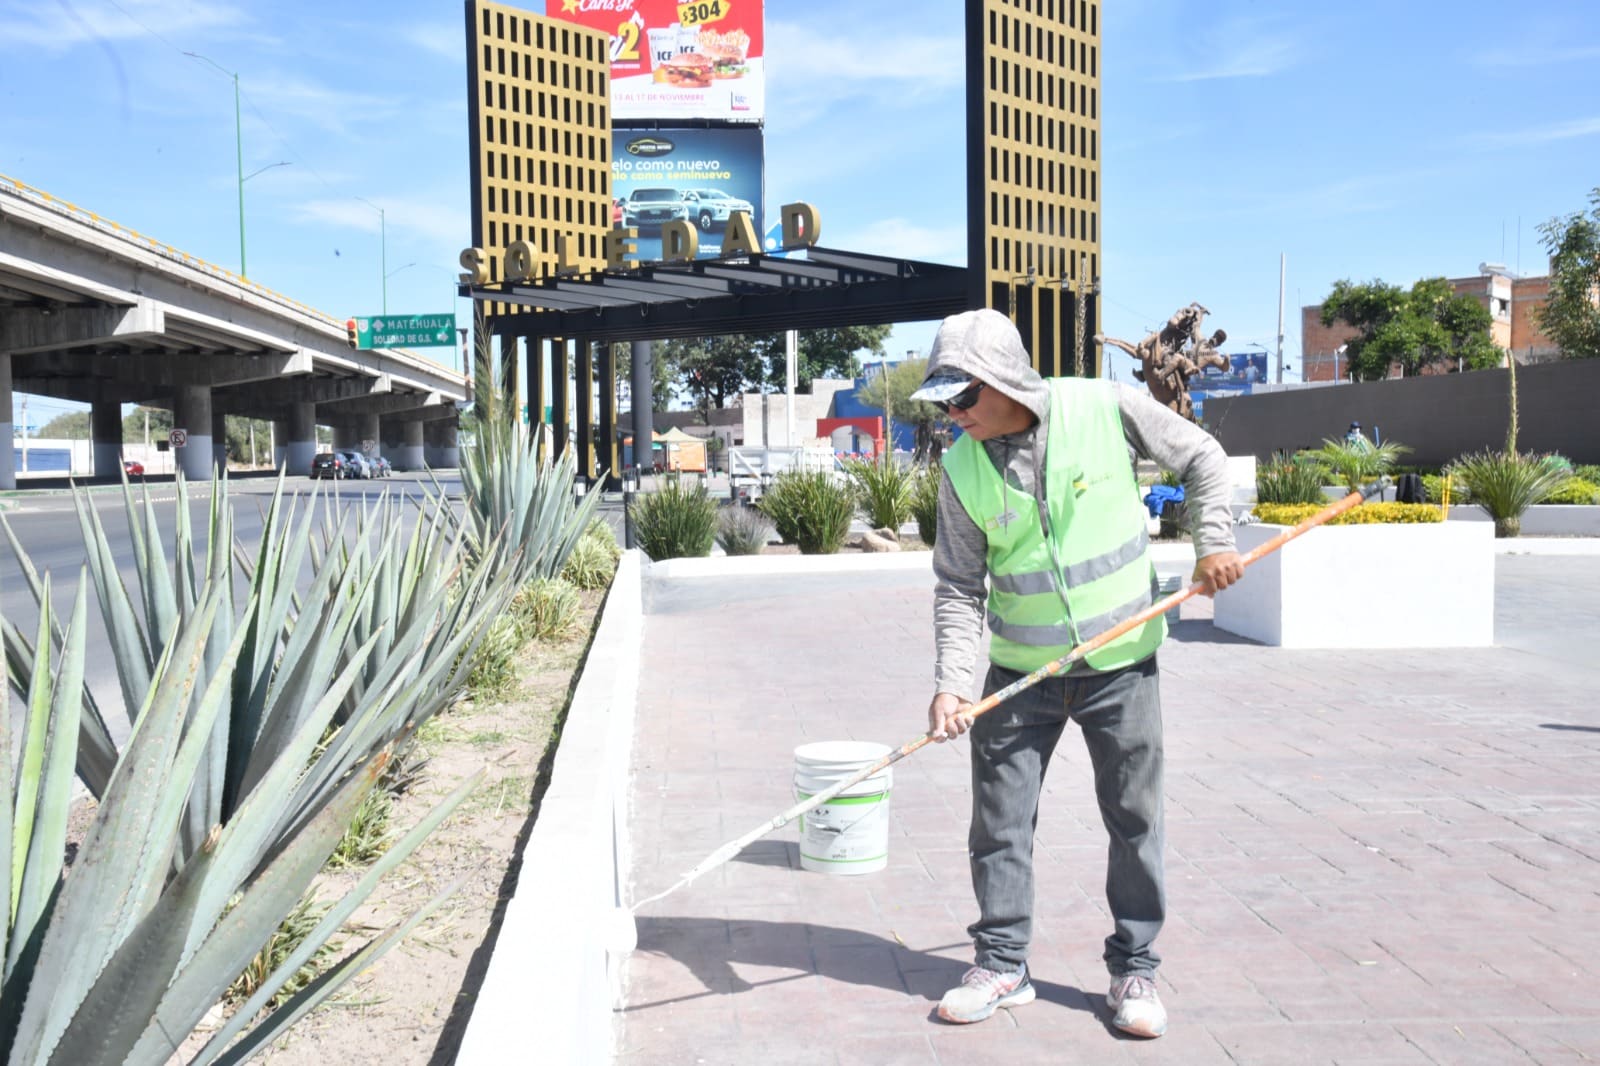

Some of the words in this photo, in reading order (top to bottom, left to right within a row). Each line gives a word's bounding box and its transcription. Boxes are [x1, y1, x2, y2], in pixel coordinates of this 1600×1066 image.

[683, 0, 720, 23] $304
[625, 93, 634, 102] AL
[647, 93, 657, 102] DE
[659, 93, 704, 102] NOVIEMBRE
[635, 160, 674, 171] como
[677, 160, 720, 170] nuevo
[631, 171, 664, 180] como
[668, 169, 731, 180] seminuevo
[459, 201, 821, 285] SOLEDAD
[387, 318, 453, 330] MATEHUALA
[373, 334, 405, 344] SOLEDAD
[407, 334, 416, 343] DE
